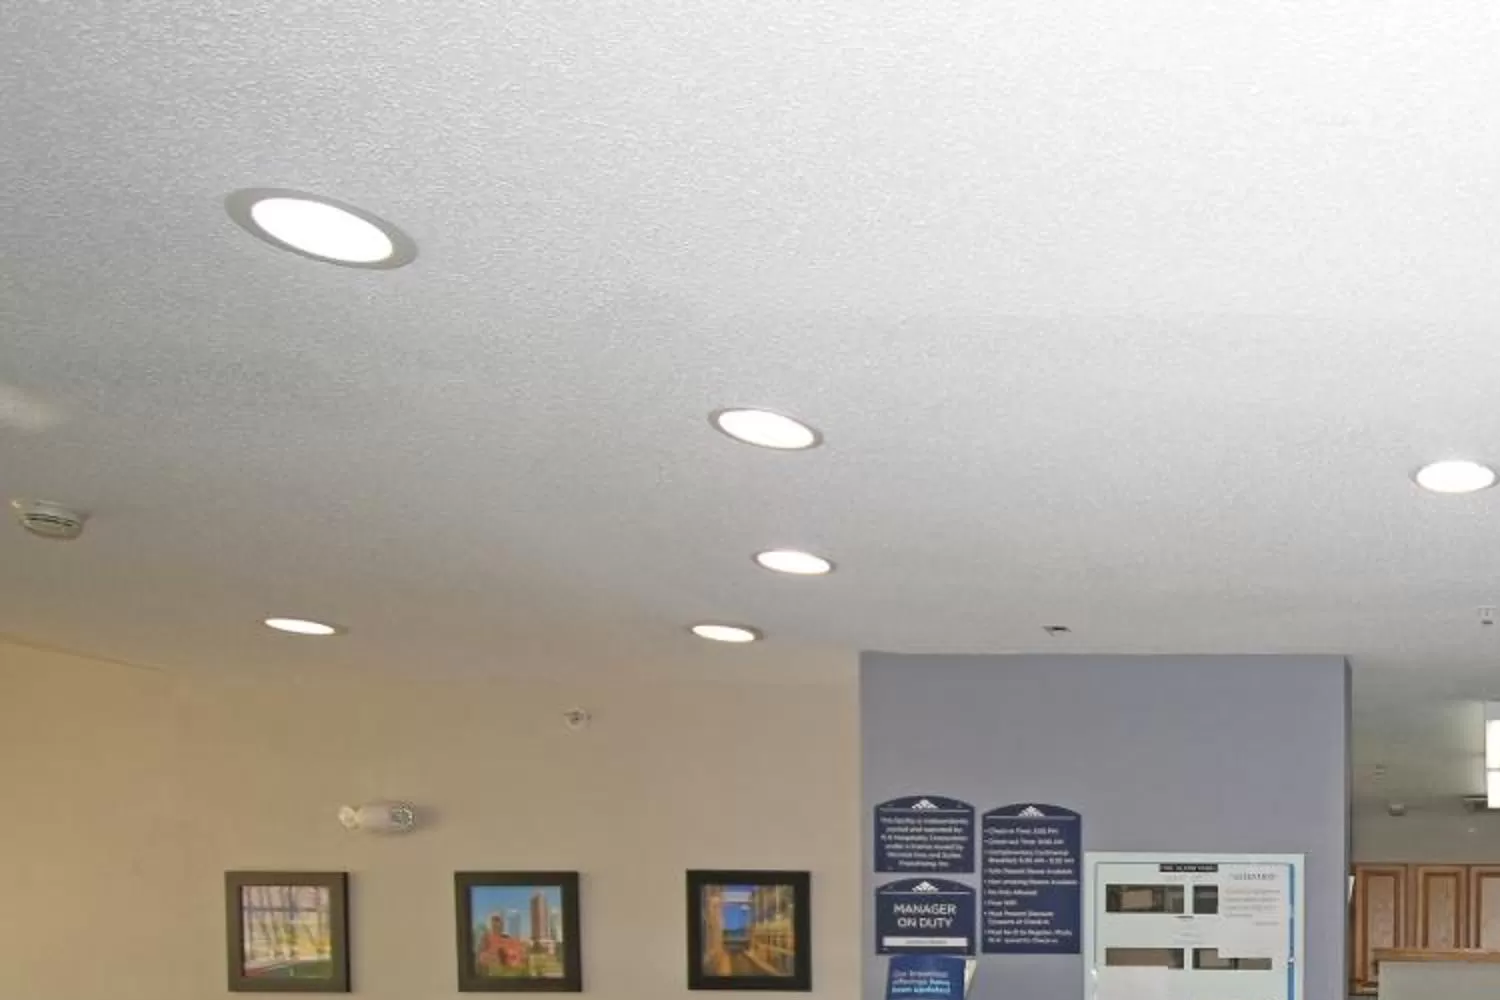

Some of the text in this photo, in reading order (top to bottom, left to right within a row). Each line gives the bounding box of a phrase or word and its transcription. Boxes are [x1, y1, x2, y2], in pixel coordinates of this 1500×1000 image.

[893, 903, 957, 915] MANAGER
[897, 917, 954, 928] ON DUTY
